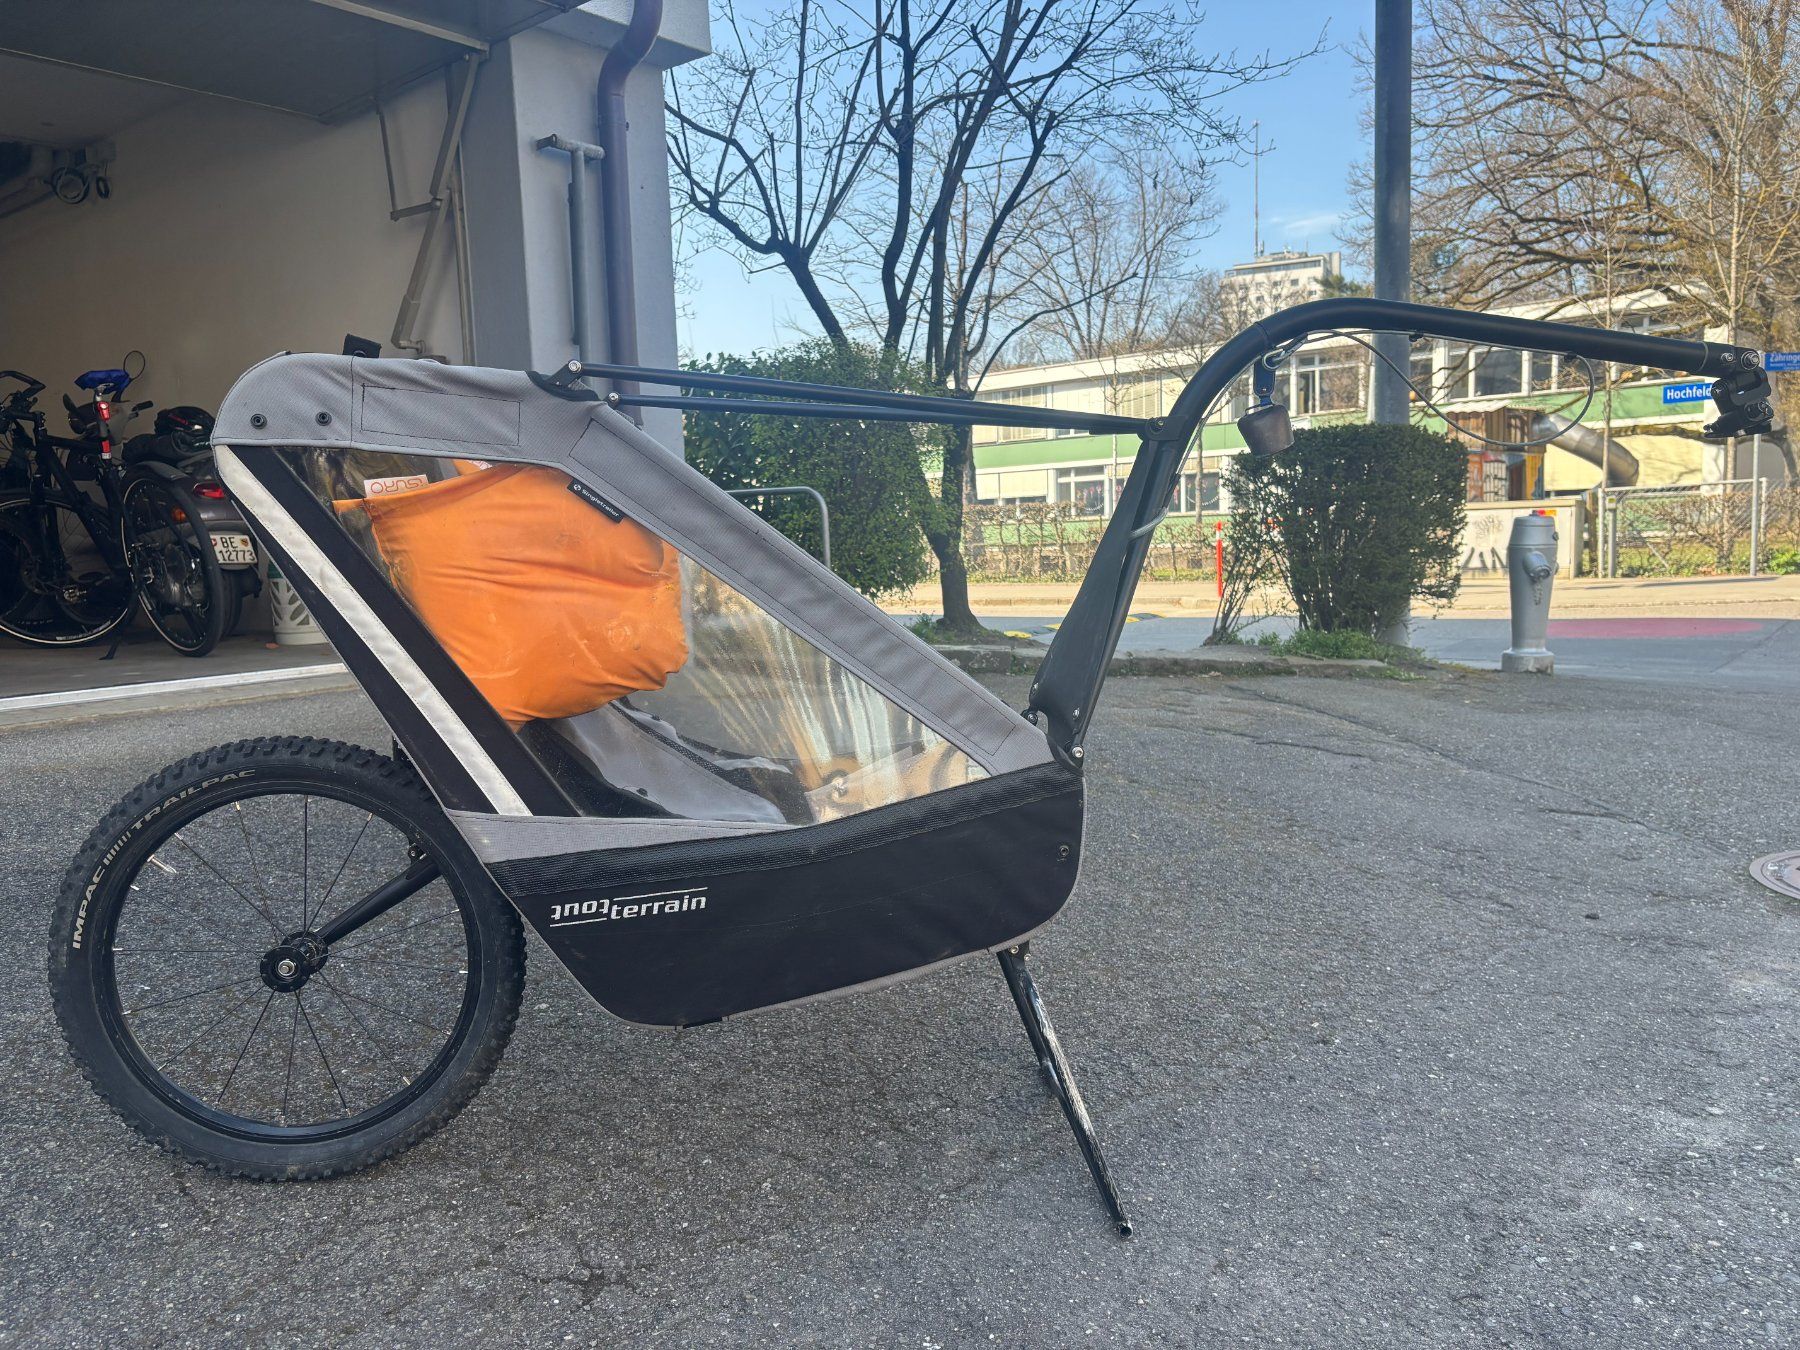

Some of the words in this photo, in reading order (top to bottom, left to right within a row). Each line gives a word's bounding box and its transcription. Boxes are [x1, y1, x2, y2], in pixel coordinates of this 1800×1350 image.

[582, 489, 620, 517] Singletrailer
[220, 536, 238, 549] BE
[219, 550, 256, 562] 12773
[72, 865, 106, 950] IMPAC
[131, 769, 256, 832] TRAILPAC
[610, 894, 707, 920] terrain
